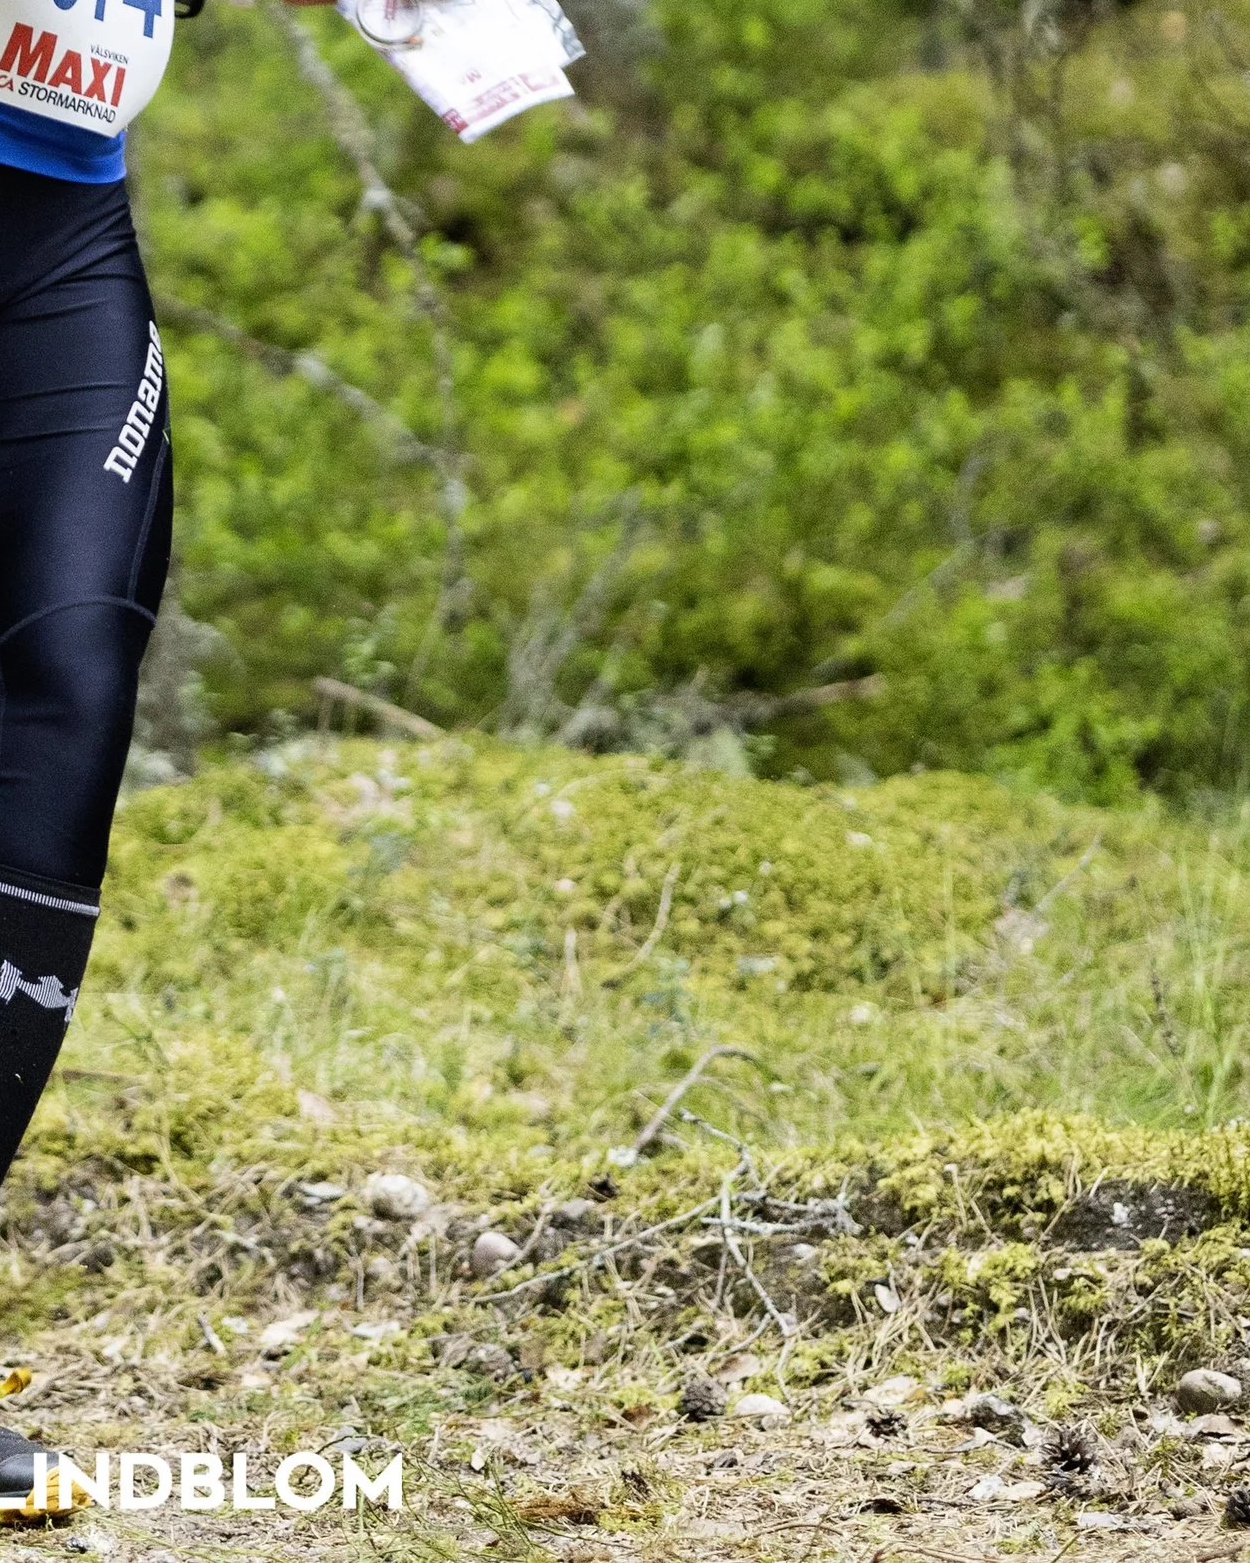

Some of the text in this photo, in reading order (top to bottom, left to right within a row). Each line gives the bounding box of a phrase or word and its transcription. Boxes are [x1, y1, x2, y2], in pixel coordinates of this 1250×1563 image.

[90, 44, 128, 65] VÅLSVIKEN
[18, 81, 116, 124] STORMARKNAD
[103, 320, 163, 483] noname
